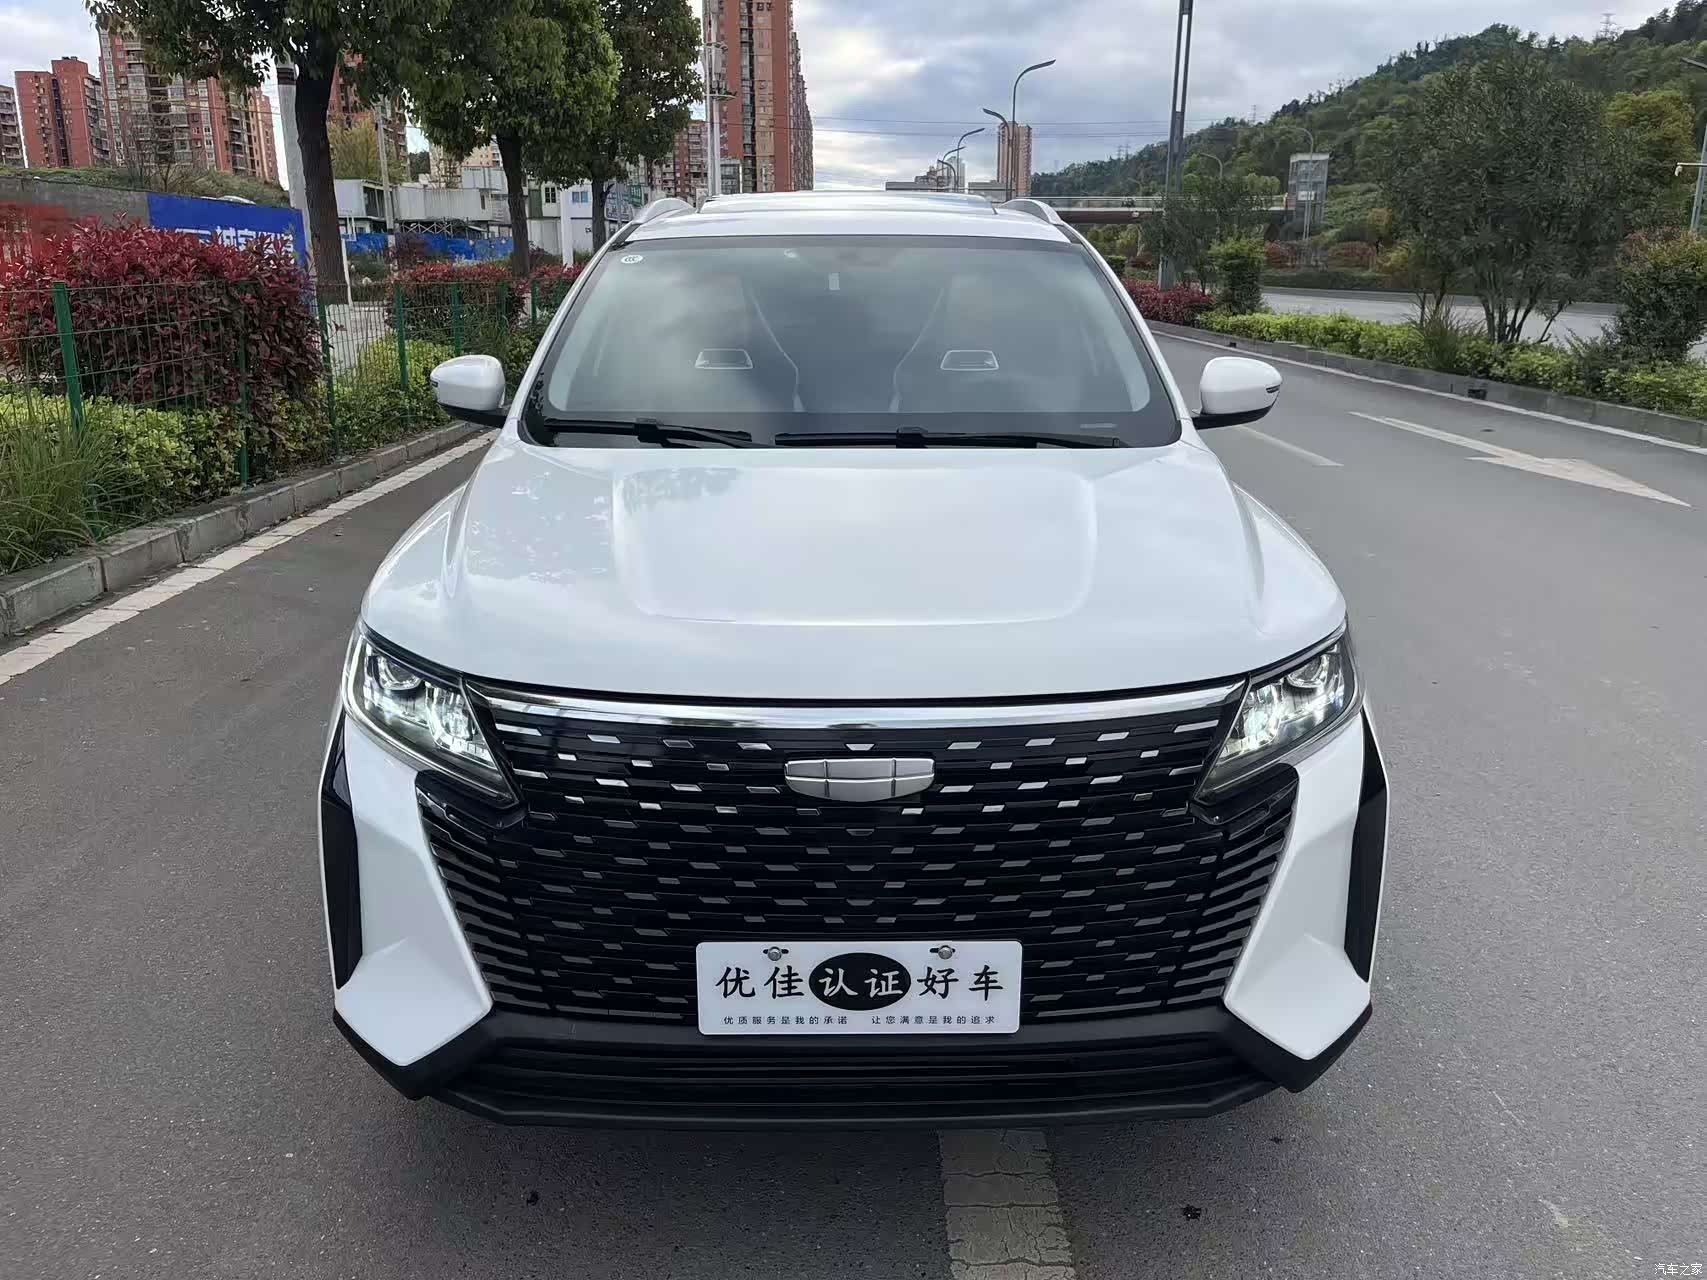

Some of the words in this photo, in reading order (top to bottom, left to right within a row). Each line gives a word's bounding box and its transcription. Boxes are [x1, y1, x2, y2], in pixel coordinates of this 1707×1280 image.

[715, 965, 1003, 1001] 优佳认证好车
[723, 1015, 848, 1025] 优质服务是我的承诺
[871, 1015, 996, 1025] 让您满意是我的追求
